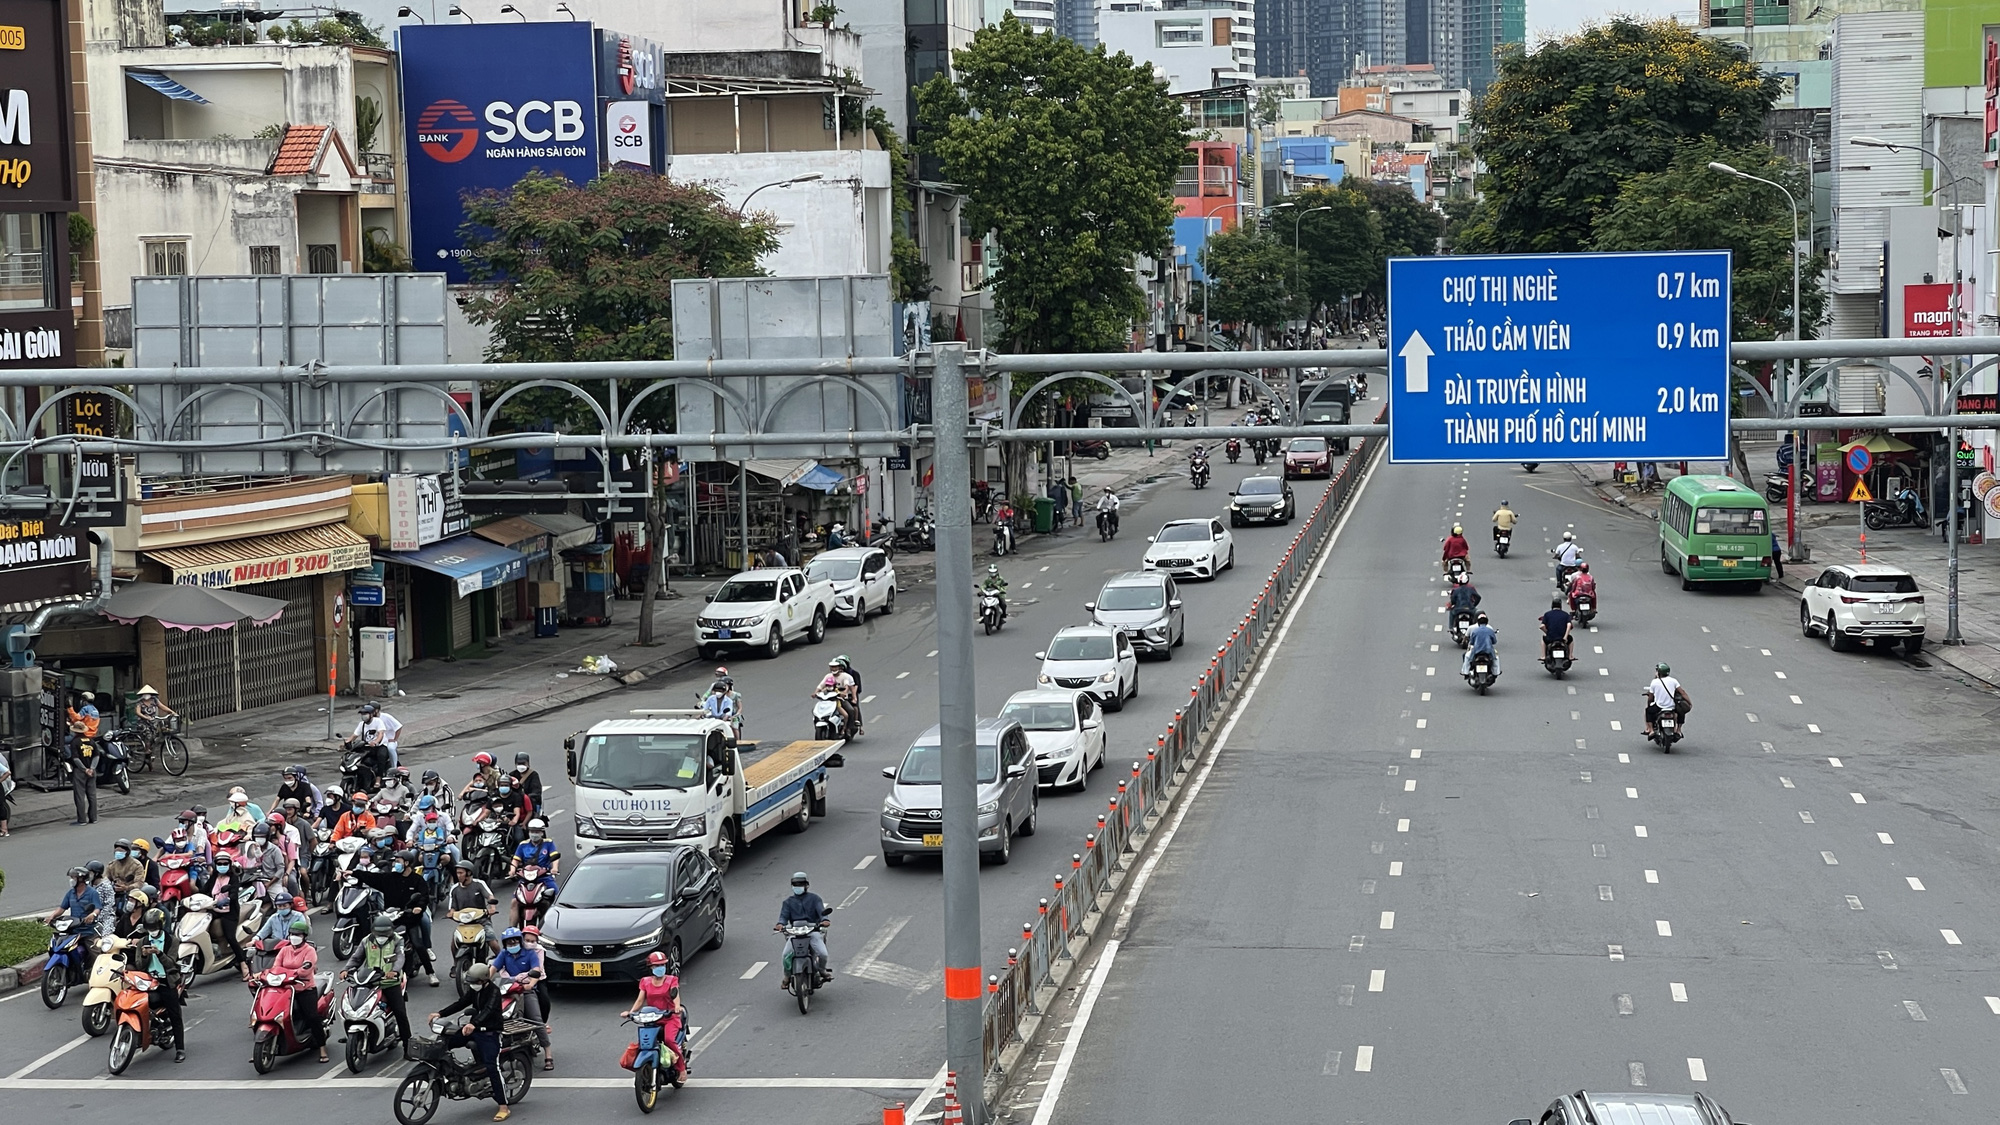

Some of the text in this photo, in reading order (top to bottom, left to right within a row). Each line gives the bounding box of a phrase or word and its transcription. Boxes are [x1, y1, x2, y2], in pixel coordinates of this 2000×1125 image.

[485, 100, 585, 142] SCB
[419, 134, 449, 142] BANK
[614, 135, 643, 147] SCB
[486, 145, 586, 158] NGÂN HÀNG SÀI GÒN
[450, 249, 472, 258] 1900
[1443, 268, 1720, 307] CHỢ THỊ NGHÈ 0,7 km
[25, 326, 61, 360] GÒN
[1444, 315, 1719, 352] THẢO CẦM VIÊN 0,9 km
[1444, 369, 1586, 405] ĐÀI TRUYỀN HÌNH
[76, 398, 102, 420] Lộc
[1657, 386, 1719, 415] 2,0 km
[1444, 408, 1647, 444] THÀNH PHỐ HỒ CHÍ MINH
[80, 459, 108, 478] ườn
[21, 520, 45, 539] Biệt
[40, 535, 77, 560] MÓN
[201, 568, 232, 588] HÀNG
[234, 557, 291, 581] NHỰA
[294, 552, 331, 573] 300
[630, 797, 649, 813] HỘ
[650, 799, 671, 811] 112
